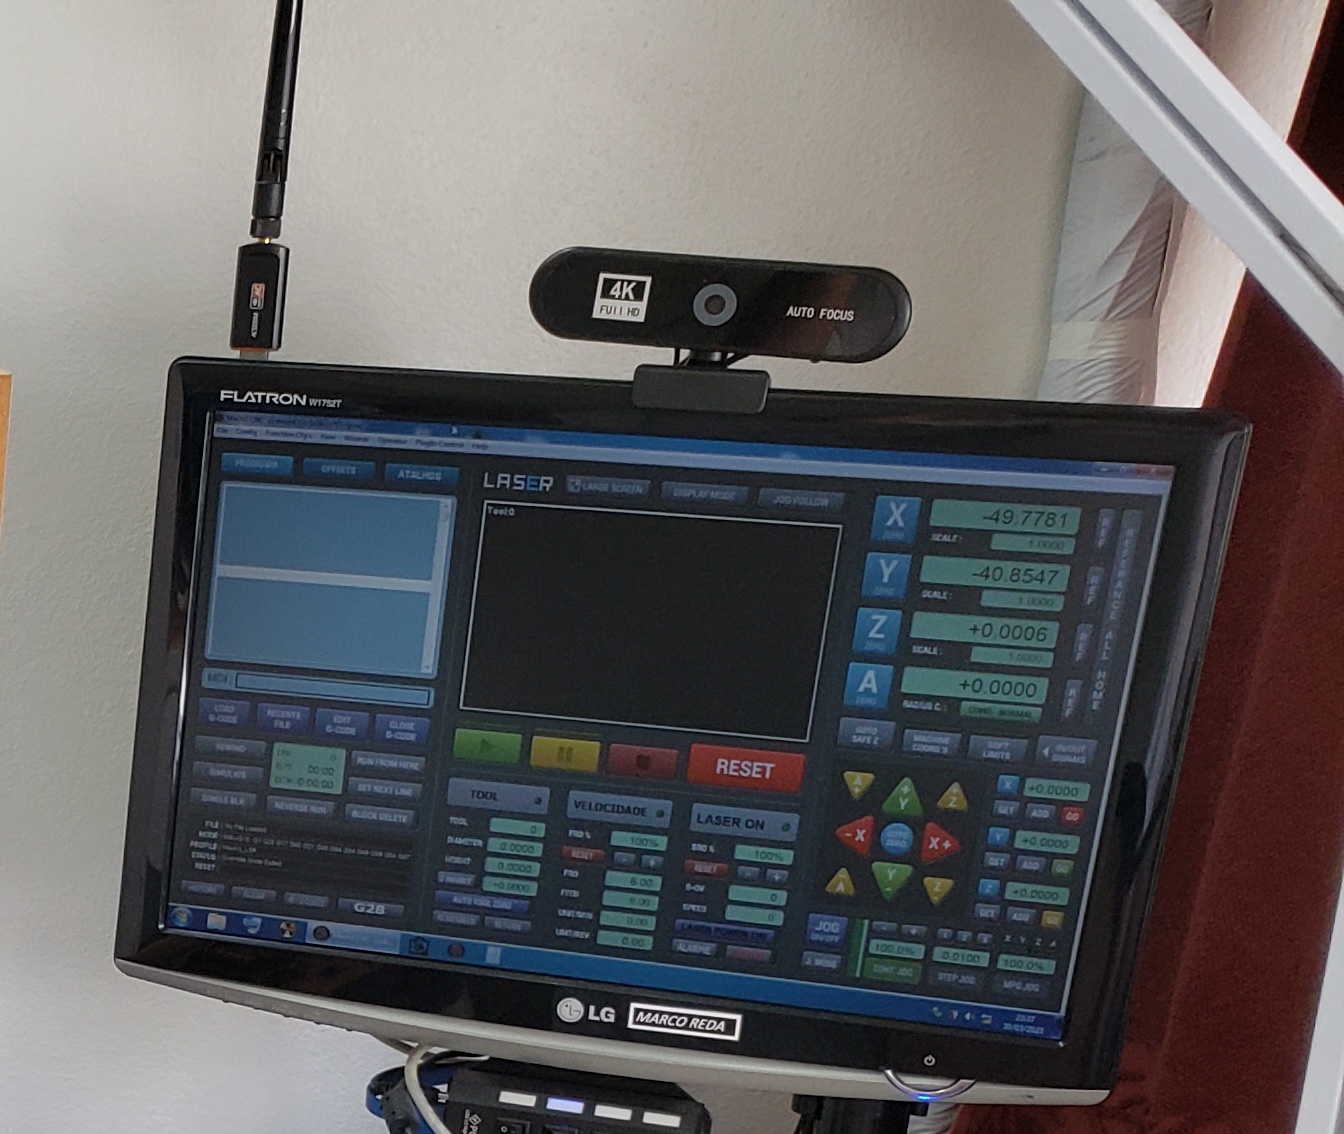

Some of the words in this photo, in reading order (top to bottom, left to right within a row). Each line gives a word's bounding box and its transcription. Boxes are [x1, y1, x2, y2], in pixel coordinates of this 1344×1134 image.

[609, 281, 636, 300] 4K
[627, 306, 640, 317] HD
[786, 305, 815, 320] AUTO
[818, 308, 855, 322] FOCUS
[220, 390, 307, 406] FLATRON
[483, 472, 554, 491] LASER
[885, 501, 906, 527] X
[982, 510, 1069, 530] -49.7781
[879, 560, 898, 583] Y
[869, 615, 888, 639] Z
[969, 623, 1048, 642] +0.0006
[858, 670, 878, 694] A
[958, 679, 1038, 698] +0.0000
[716, 758, 776, 780] RESET
[573, 799, 648, 818] VELOCIDADE
[696, 812, 741, 829] LASER
[744, 818, 765, 832] ON
[353, 902, 386, 915] G28
[815, 919, 840, 934] JOG
[588, 1005, 616, 1023] LG
[634, 1010, 688, 1028] MARCO
[688, 1016, 726, 1034] REDA
